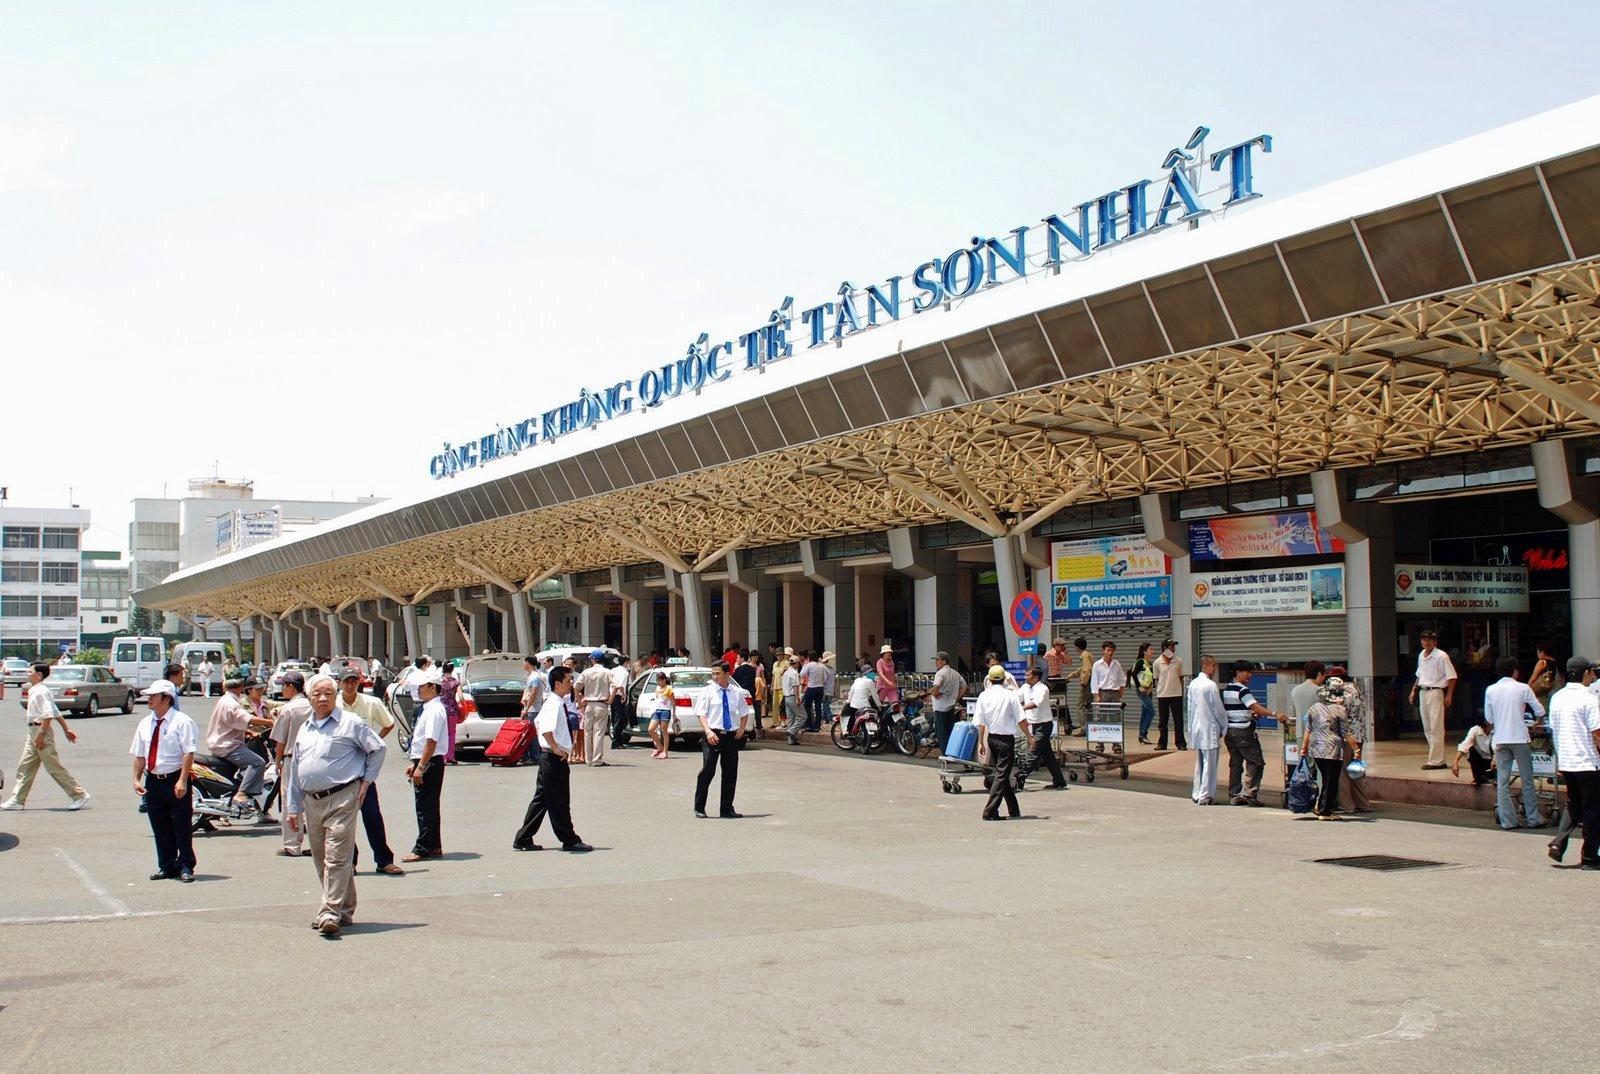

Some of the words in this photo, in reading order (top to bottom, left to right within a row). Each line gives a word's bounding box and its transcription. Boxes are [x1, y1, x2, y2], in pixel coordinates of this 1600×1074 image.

[430, 441, 477, 480] CẢNG
[480, 423, 536, 464] HÀNG
[542, 387, 634, 444] KHÔNG
[639, 332, 732, 408] QUỐC
[739, 296, 793, 371] TẾ
[802, 276, 902, 350] TÂN
[913, 227, 1028, 314] SƠN
[1041, 126, 1272, 268] NHẤT
[1079, 594, 1146, 608] AGRIBANK
[1469, 600, 1483, 609] DỊCH
